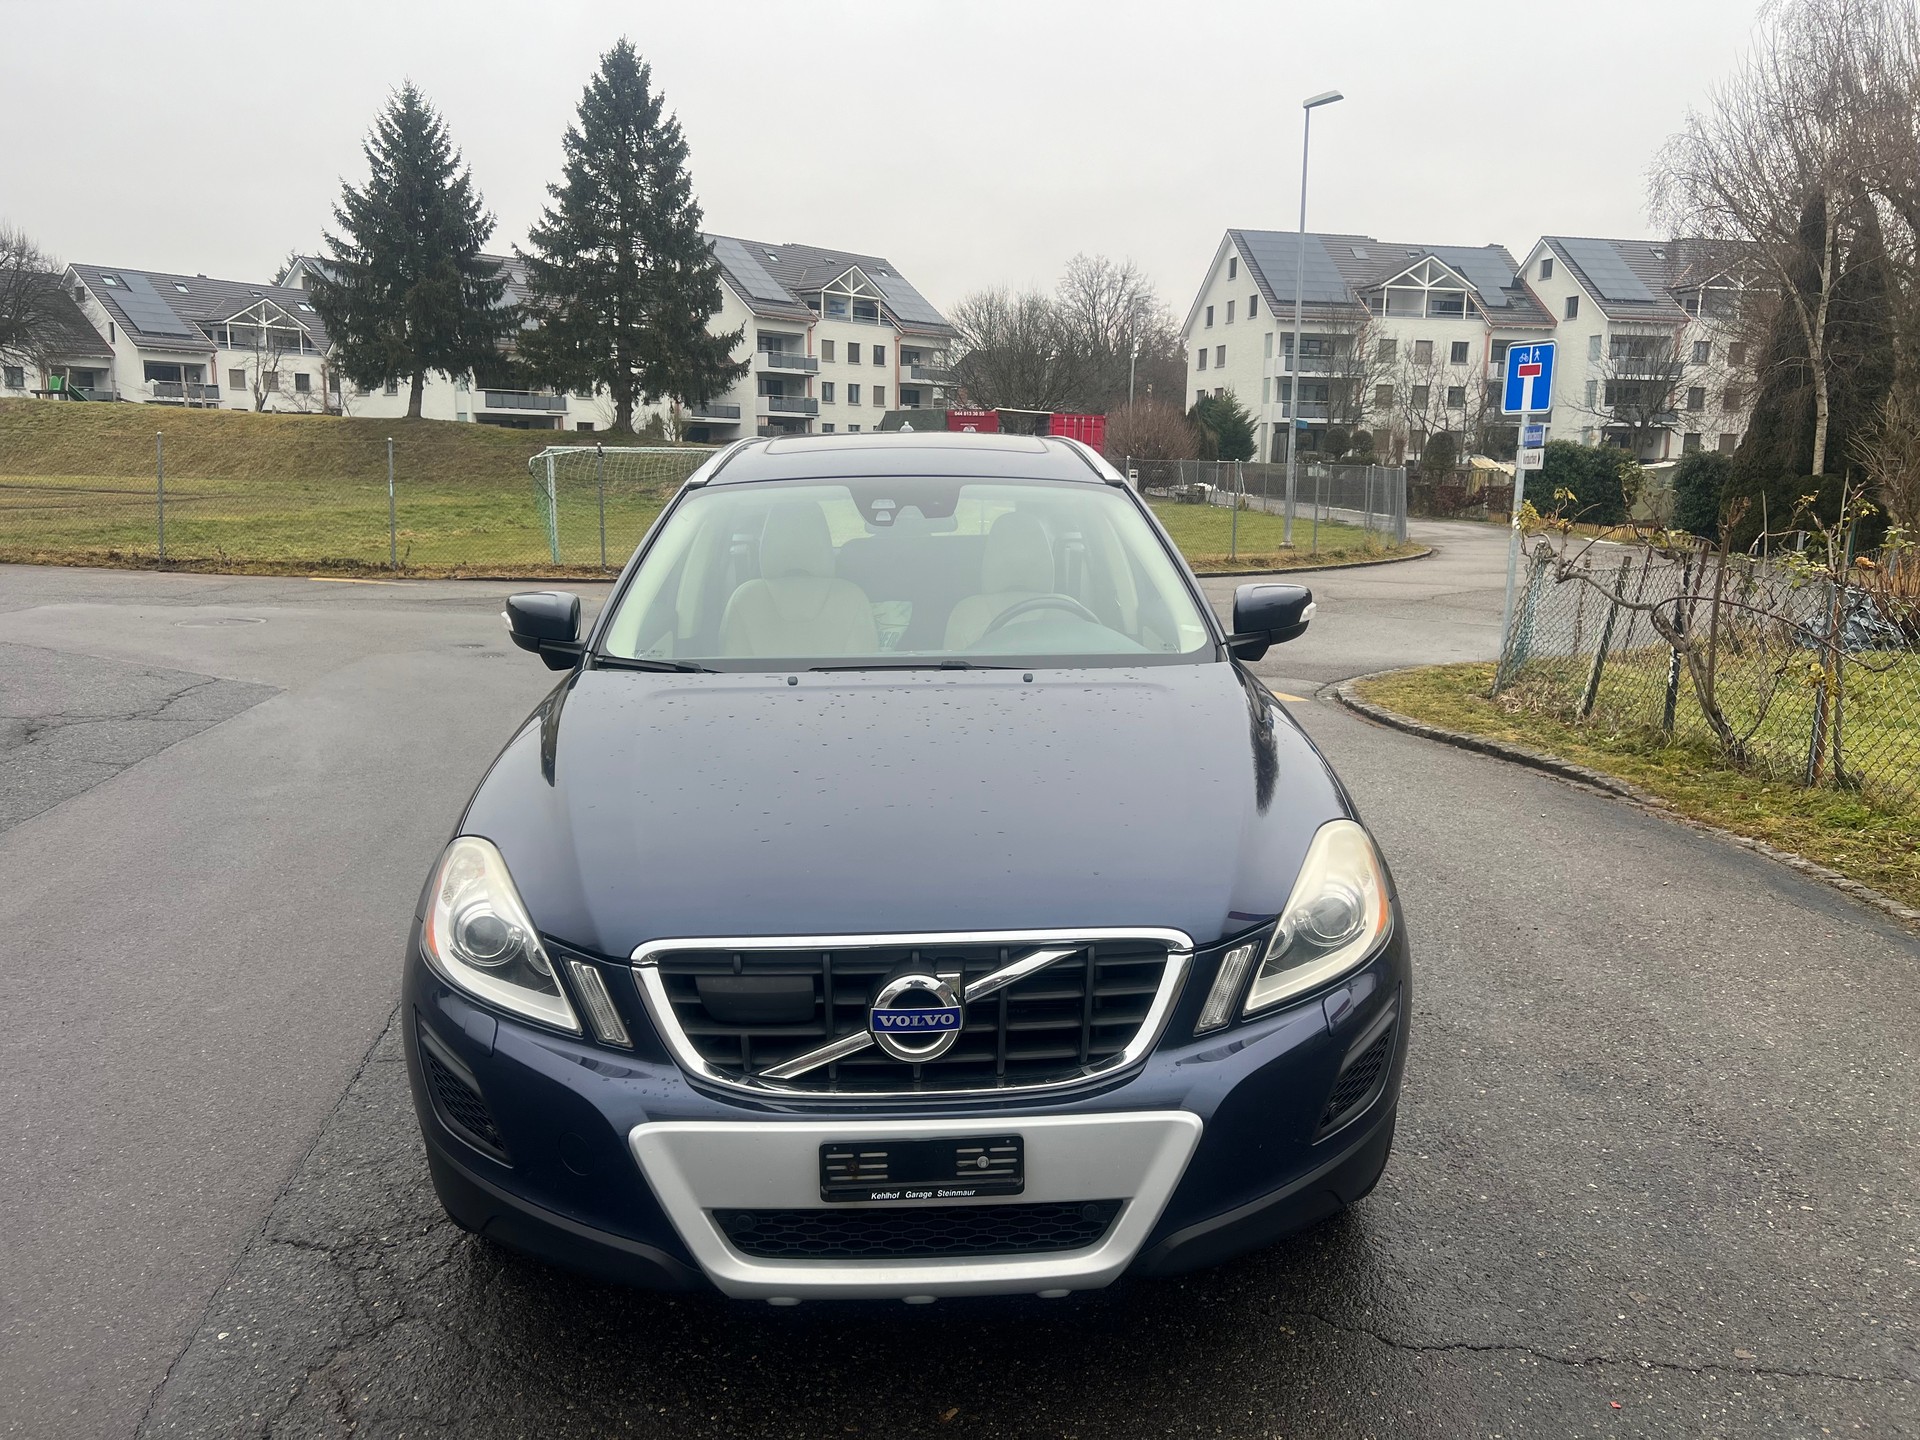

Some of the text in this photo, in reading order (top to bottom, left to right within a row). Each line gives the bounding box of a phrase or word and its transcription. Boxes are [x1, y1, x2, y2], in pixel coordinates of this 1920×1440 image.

[878, 1014, 955, 1026] VOLVO
[905, 1191, 933, 1200] Garage
[937, 1190, 976, 1198] Steinmaur
